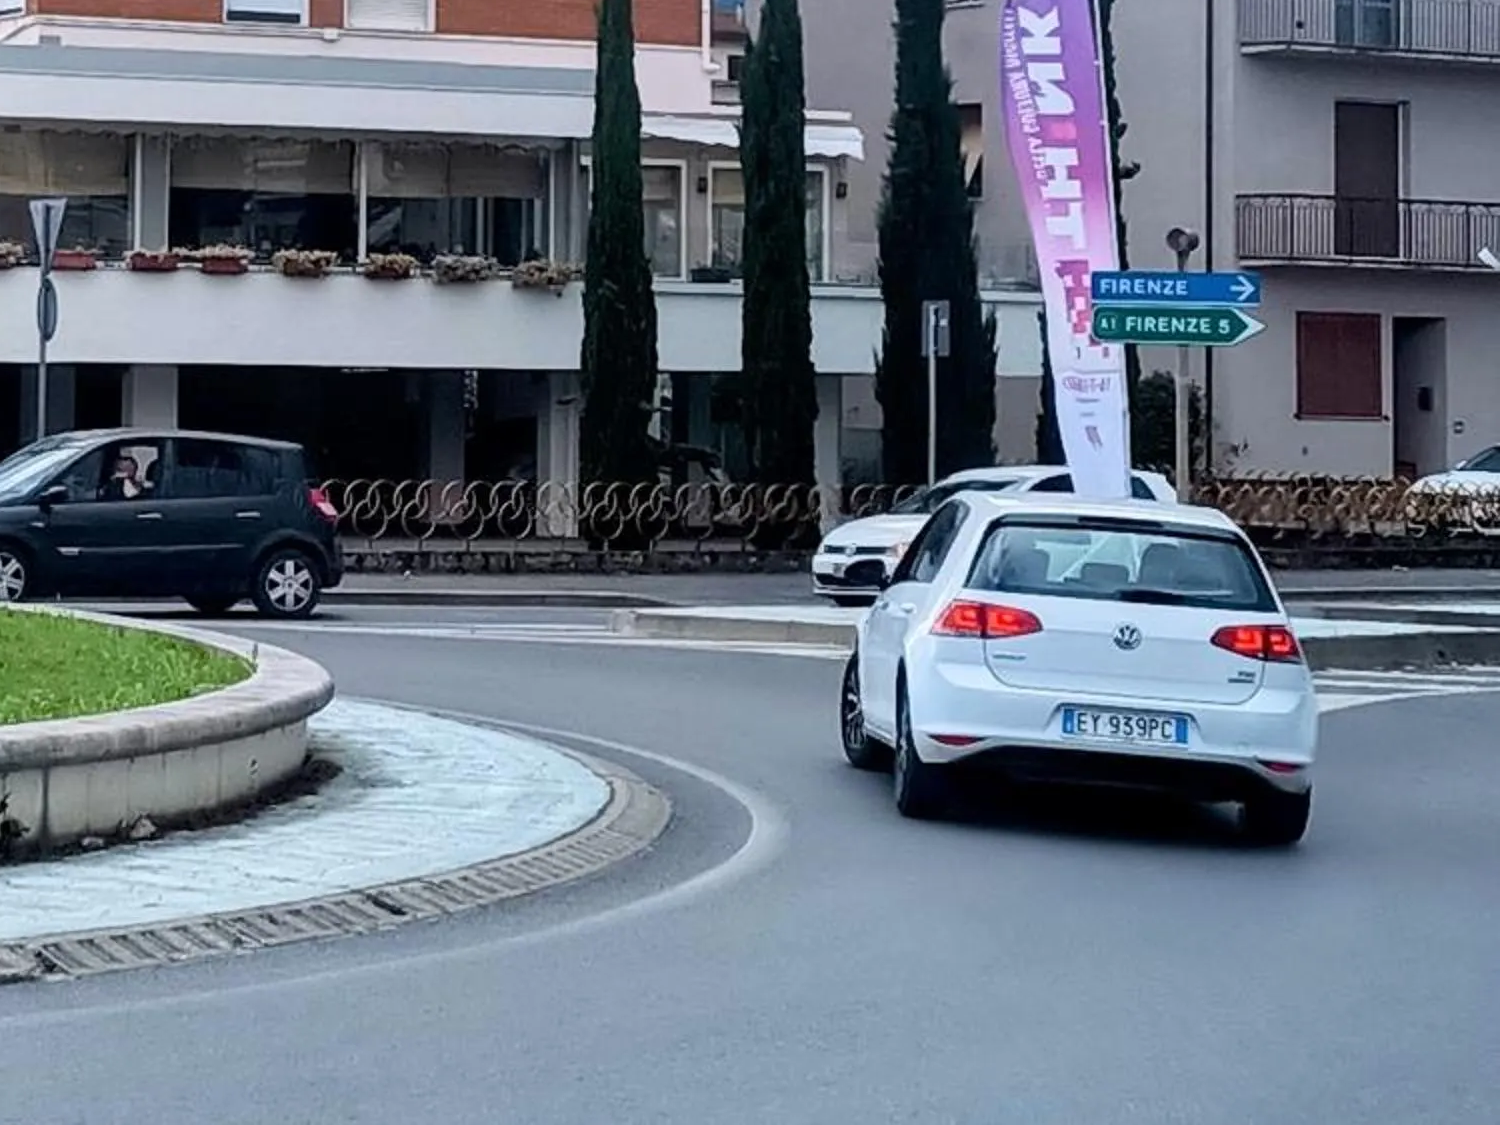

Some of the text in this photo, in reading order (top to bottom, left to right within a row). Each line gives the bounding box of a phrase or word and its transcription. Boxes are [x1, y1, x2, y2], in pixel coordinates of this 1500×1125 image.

[1100, 279, 1188, 295] FIRENZE
[1125, 316, 1211, 333] FIRENZE
[1218, 318, 1231, 335] 5
[1077, 712, 1100, 733] EY
